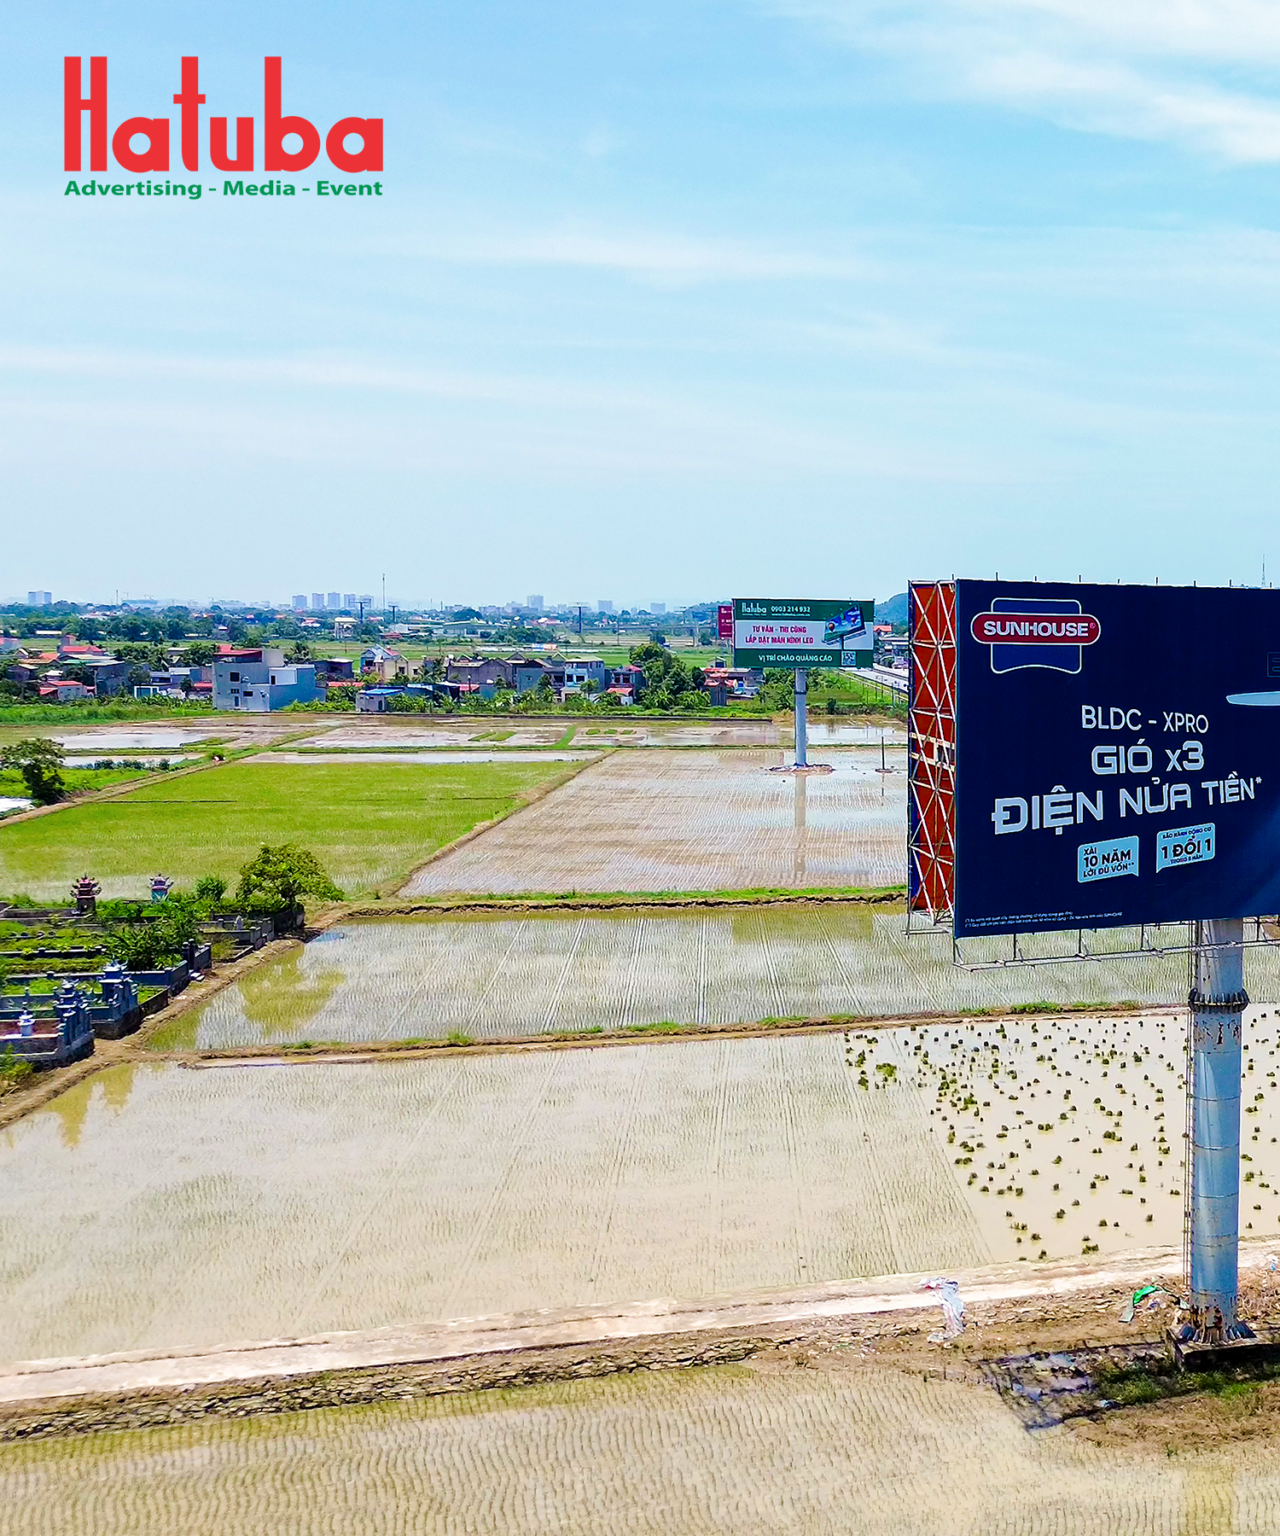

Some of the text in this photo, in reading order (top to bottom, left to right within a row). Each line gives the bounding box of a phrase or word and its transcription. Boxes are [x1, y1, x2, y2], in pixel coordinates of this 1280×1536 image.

[741, 602, 767, 613] Hatuba
[983, 621, 1089, 637] SUNHOUSE
[1081, 705, 1142, 731] BLDC
[1162, 711, 1209, 733] XPRO
[1091, 738, 1204, 775] GIÓ x3
[991, 785, 1104, 836] ĐIỆN
[1119, 776, 1192, 819] NỬA
[1083, 846, 1097, 856] XÀI
[1161, 835, 1211, 859] 1 ĐỔI 1
[1083, 848, 1131, 868] 10 NĂM
[1083, 867, 1097, 878] LỜI
